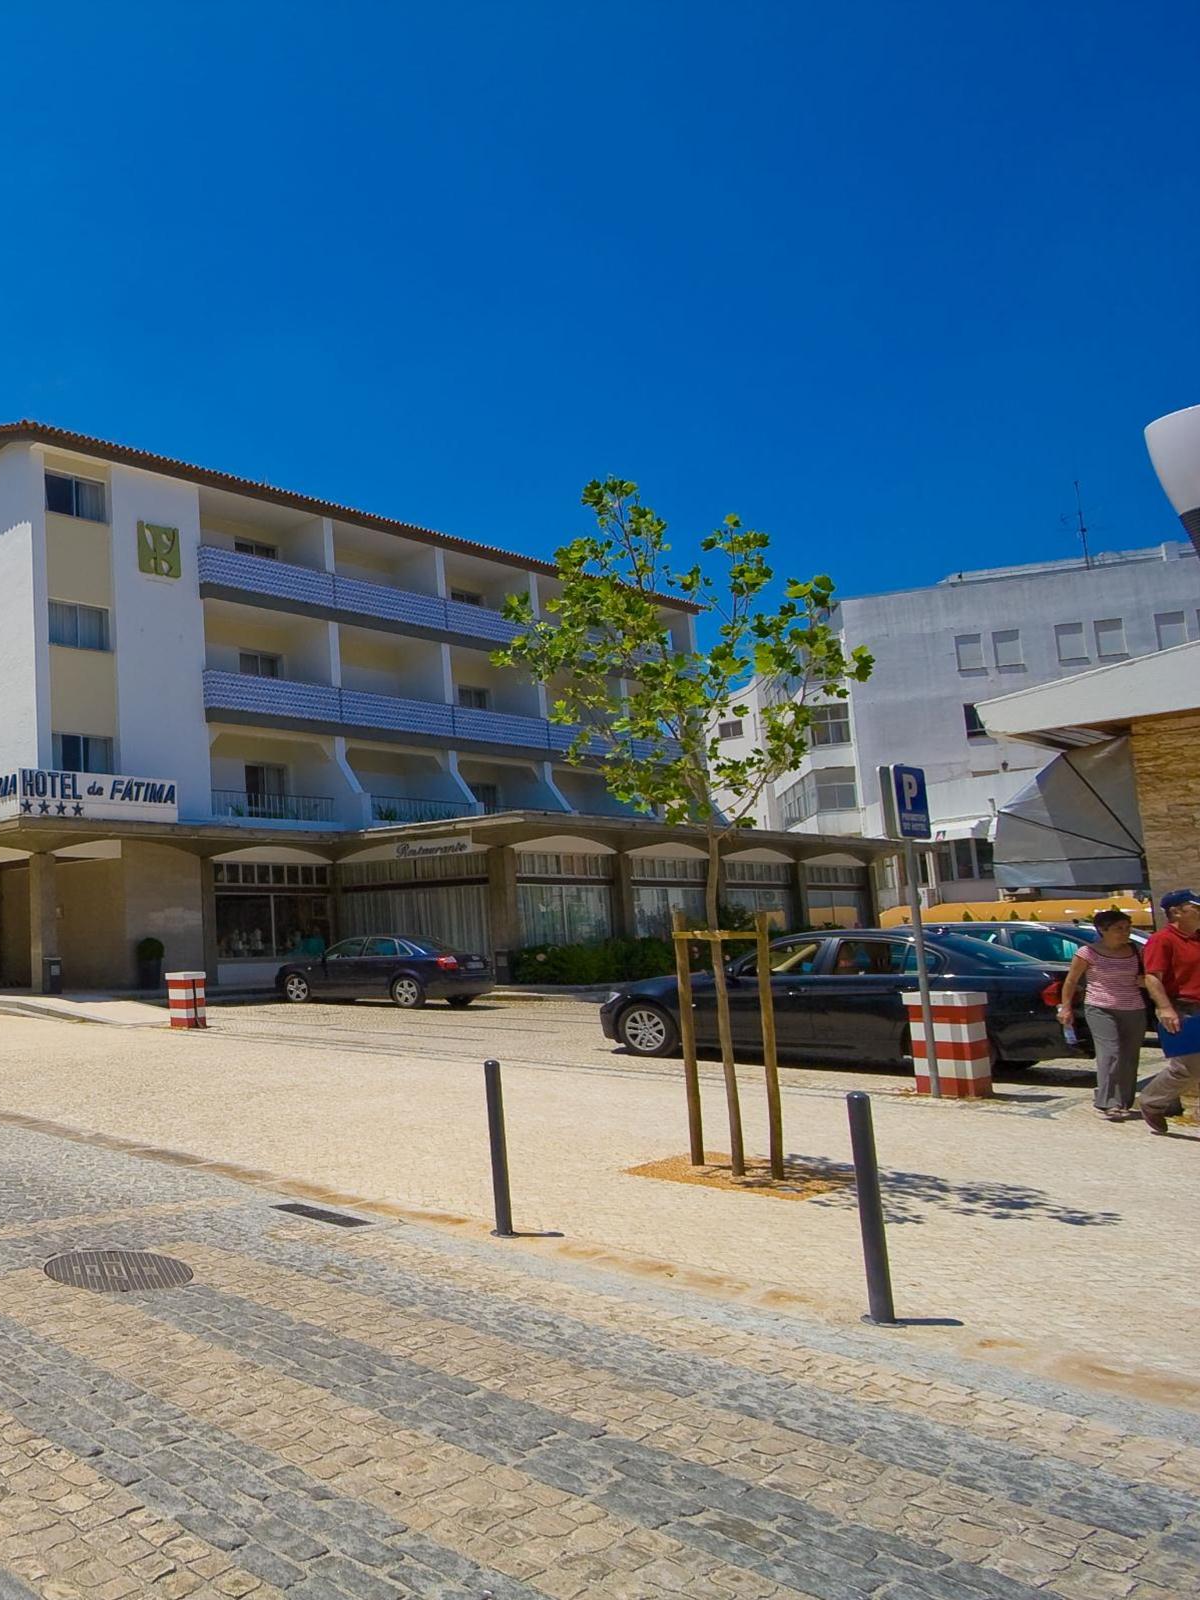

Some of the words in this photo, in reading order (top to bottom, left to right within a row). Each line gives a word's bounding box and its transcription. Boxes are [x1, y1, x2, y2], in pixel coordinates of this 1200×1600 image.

[22, 768, 83, 800] HOTEL
[86, 781, 104, 797] de
[109, 778, 176, 805] FÁTIMA
[902, 773, 918, 810] P
